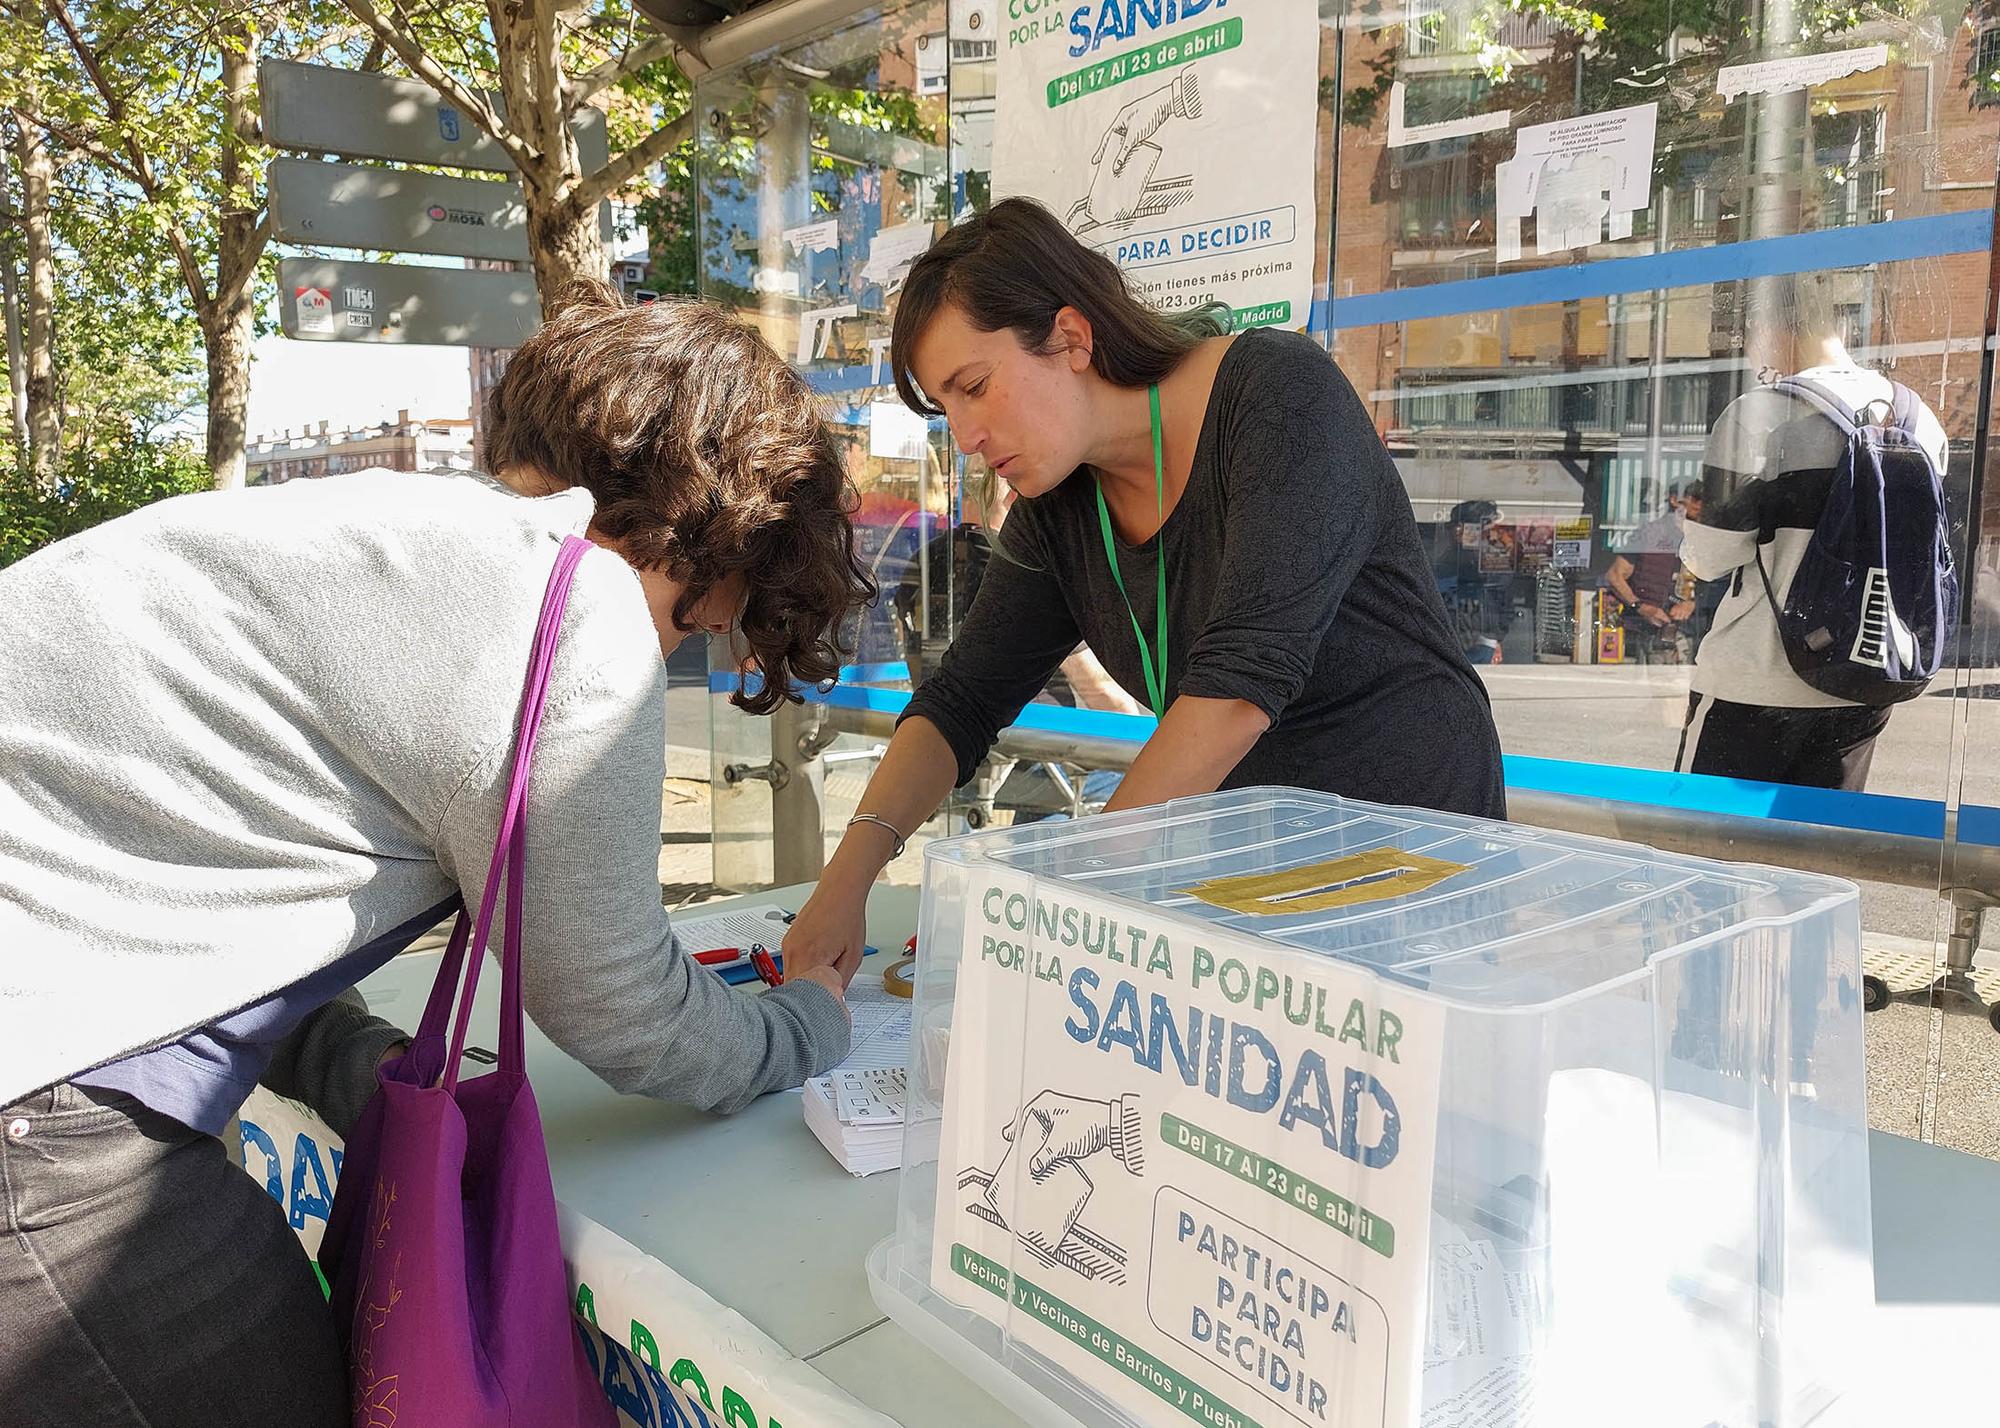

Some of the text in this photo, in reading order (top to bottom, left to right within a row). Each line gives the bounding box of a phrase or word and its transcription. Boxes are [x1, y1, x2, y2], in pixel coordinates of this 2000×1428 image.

[1009, 21, 1039, 49] POR
[1045, 11, 1064, 33] LA
[1059, 27, 1226, 99] Del 17 Al 23 de abril
[1117, 219, 1272, 265] PARA DECIDIR
[1167, 276, 1206, 290] tienes
[1211, 270, 1237, 284] más
[1242, 261, 1293, 280] próxima
[1241, 305, 1284, 324] Madrid
[982, 887, 1403, 1065] CONSULTA POPULAR
[982, 934, 1401, 1170] POR LA SANIDAD
[1178, 1124, 1206, 1155] Del
[1214, 1143, 1234, 1166] 17
[1239, 1154, 1260, 1180] Al
[1267, 1167, 1288, 1195] 23
[1295, 1184, 1318, 1210] de
[1178, 1210, 1357, 1344] PARTICIPA
[1217, 1275, 1305, 1360] PARA
[1019, 1287, 1027, 1305] y
[1032, 1292, 1087, 1339] Vecinas
[1092, 1331, 1110, 1353] de
[1115, 1343, 1172, 1393] Barrios
[1177, 1386, 1187, 1405] y
[1191, 1305, 1327, 1421] DECIDIR
